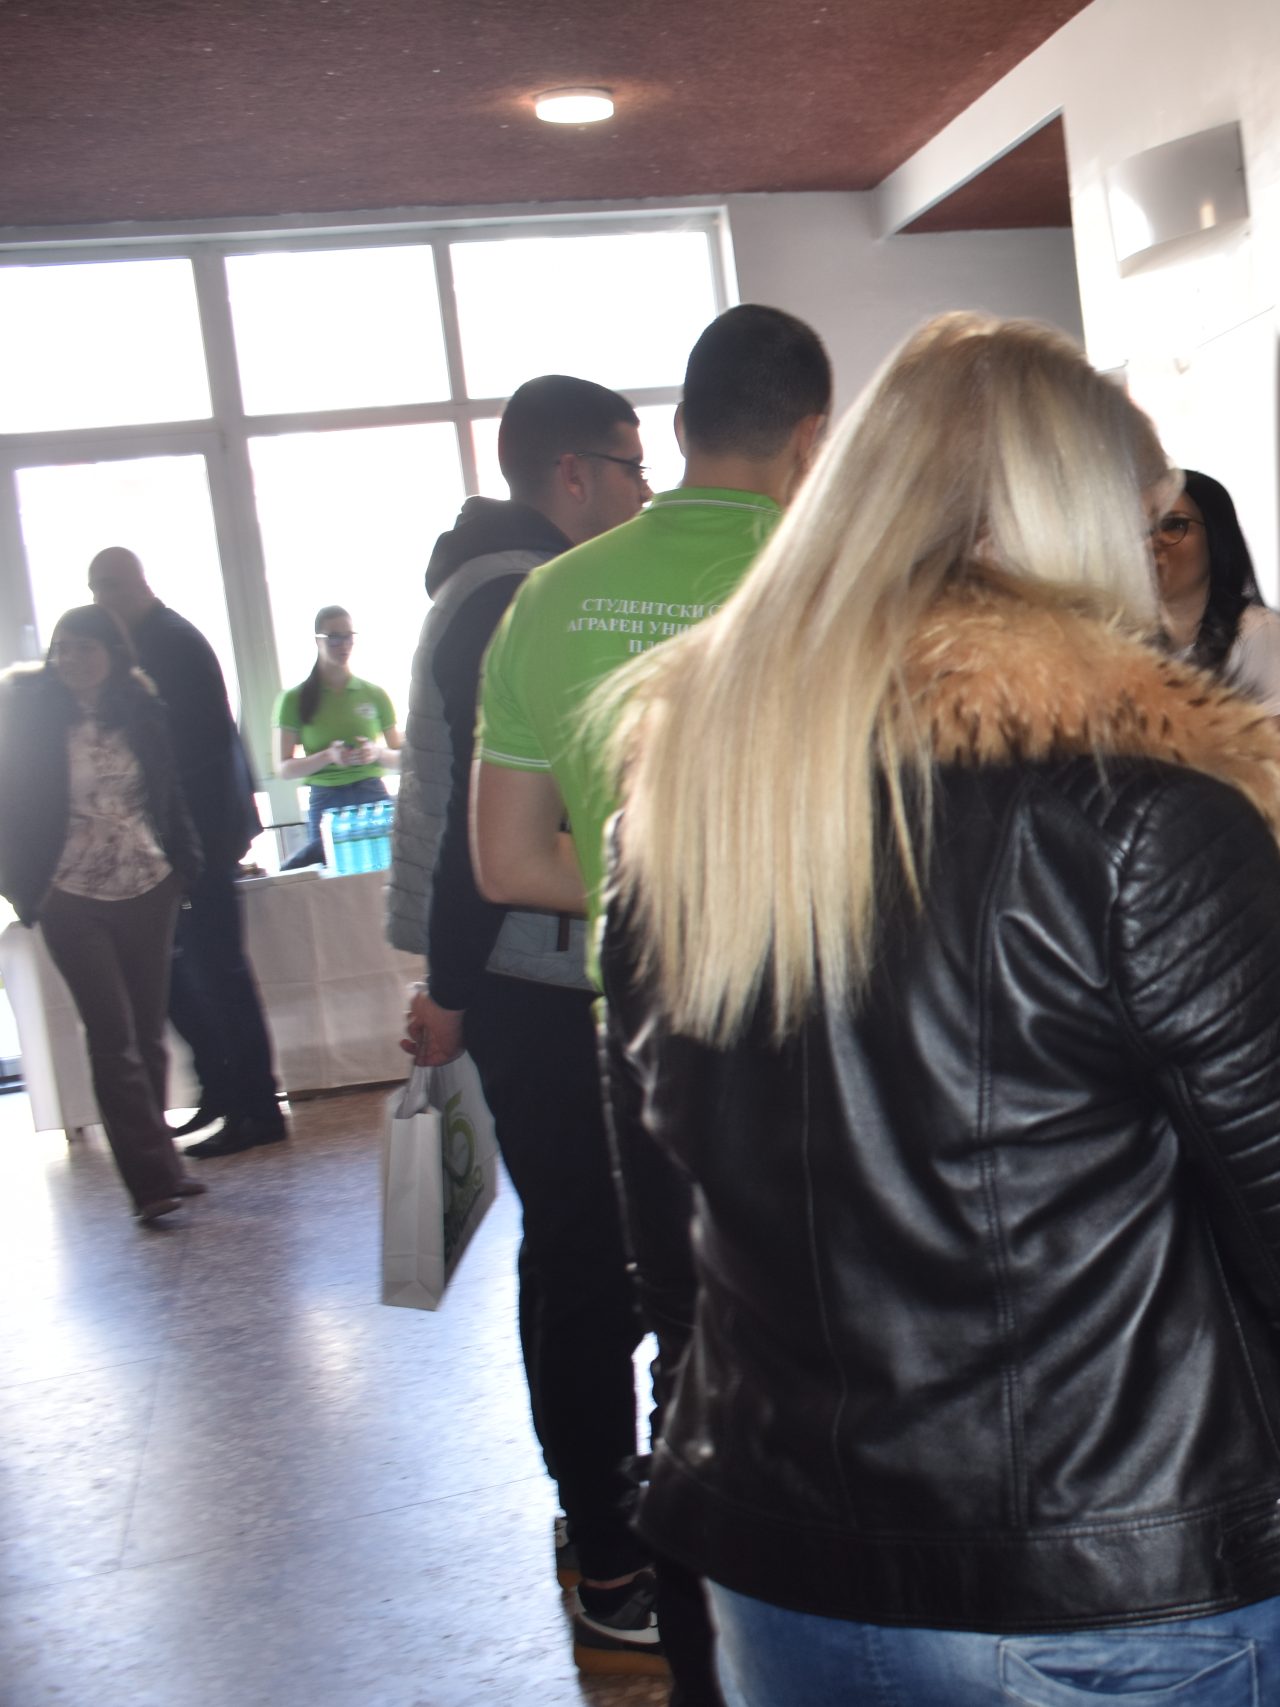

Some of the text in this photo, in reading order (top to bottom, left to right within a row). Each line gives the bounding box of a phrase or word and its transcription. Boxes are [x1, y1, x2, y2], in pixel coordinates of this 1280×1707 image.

[582, 599, 704, 618] СТУДЕНТСКИ
[567, 617, 690, 637] АГРАРЕН УНИ
